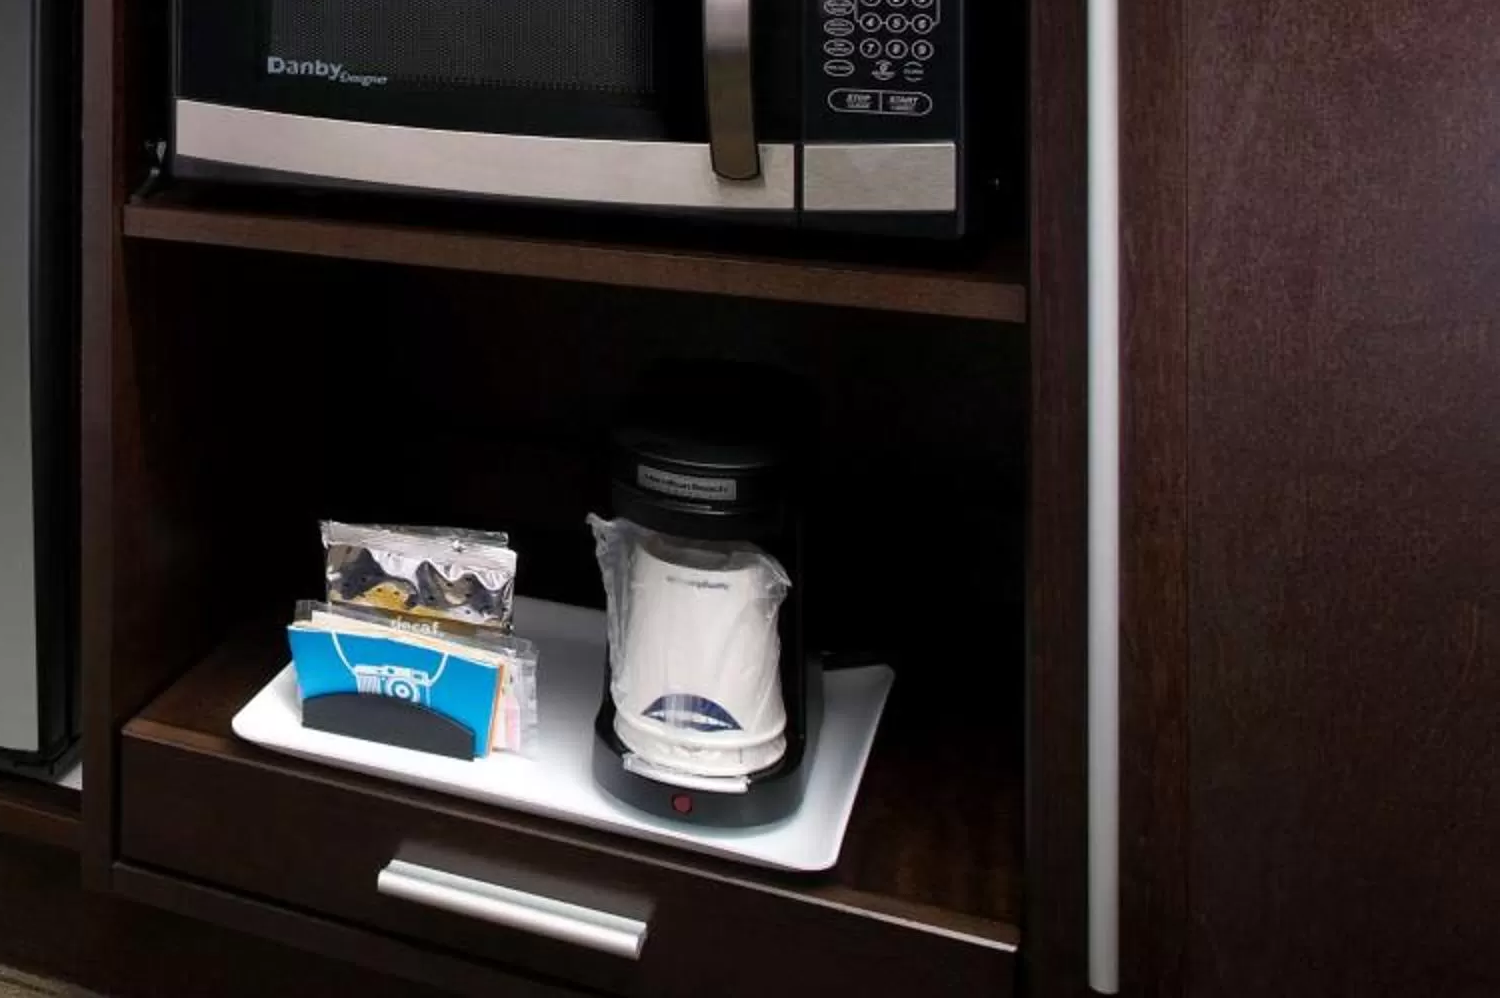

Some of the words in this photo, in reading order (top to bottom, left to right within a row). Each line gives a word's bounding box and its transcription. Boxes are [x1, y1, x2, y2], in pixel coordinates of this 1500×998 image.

[865, 18, 874, 27] 4
[892, 18, 901, 28] 5
[918, 19, 927, 29] 6
[866, 43, 875, 53] 7
[267, 56, 343, 81] Danby
